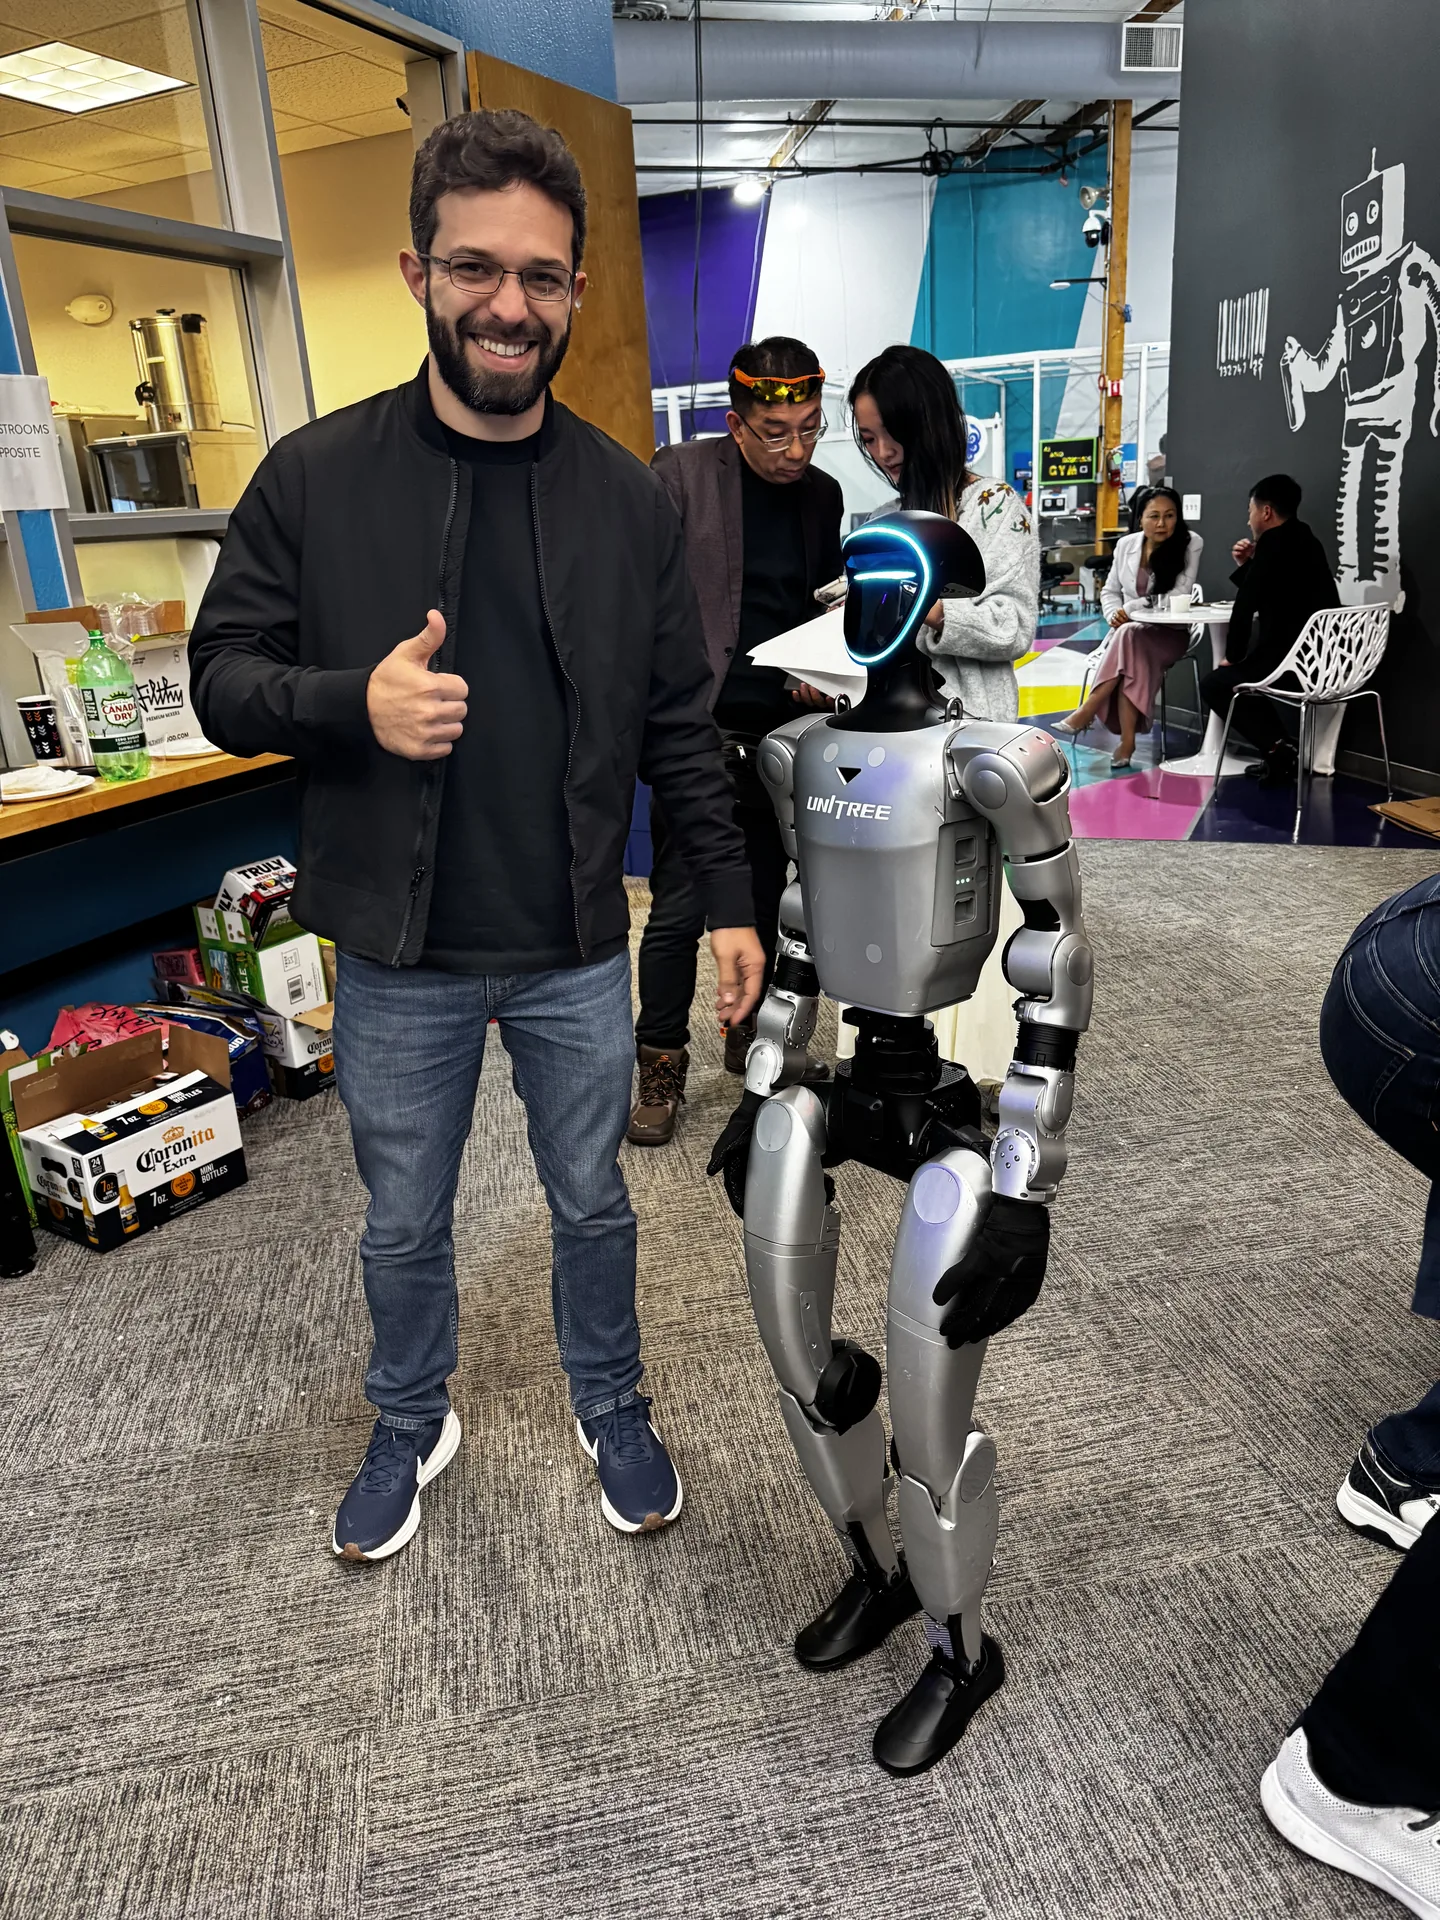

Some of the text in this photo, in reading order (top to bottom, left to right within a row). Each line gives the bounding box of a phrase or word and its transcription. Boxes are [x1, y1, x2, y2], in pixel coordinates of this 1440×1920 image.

[1049, 465, 1077, 476] GYM
[114, 712, 132, 721] DRY
[806, 794, 892, 821] UNITREE
[237, 858, 286, 880] TRULY
[238, 967, 252, 995] ALE
[136, 1127, 216, 1174] Coronita
[91, 1156, 101, 1169] 24
[163, 1154, 197, 1175] Extra
[199, 1163, 215, 1176] MINI
[201, 1164, 229, 1184] BOTTLES
